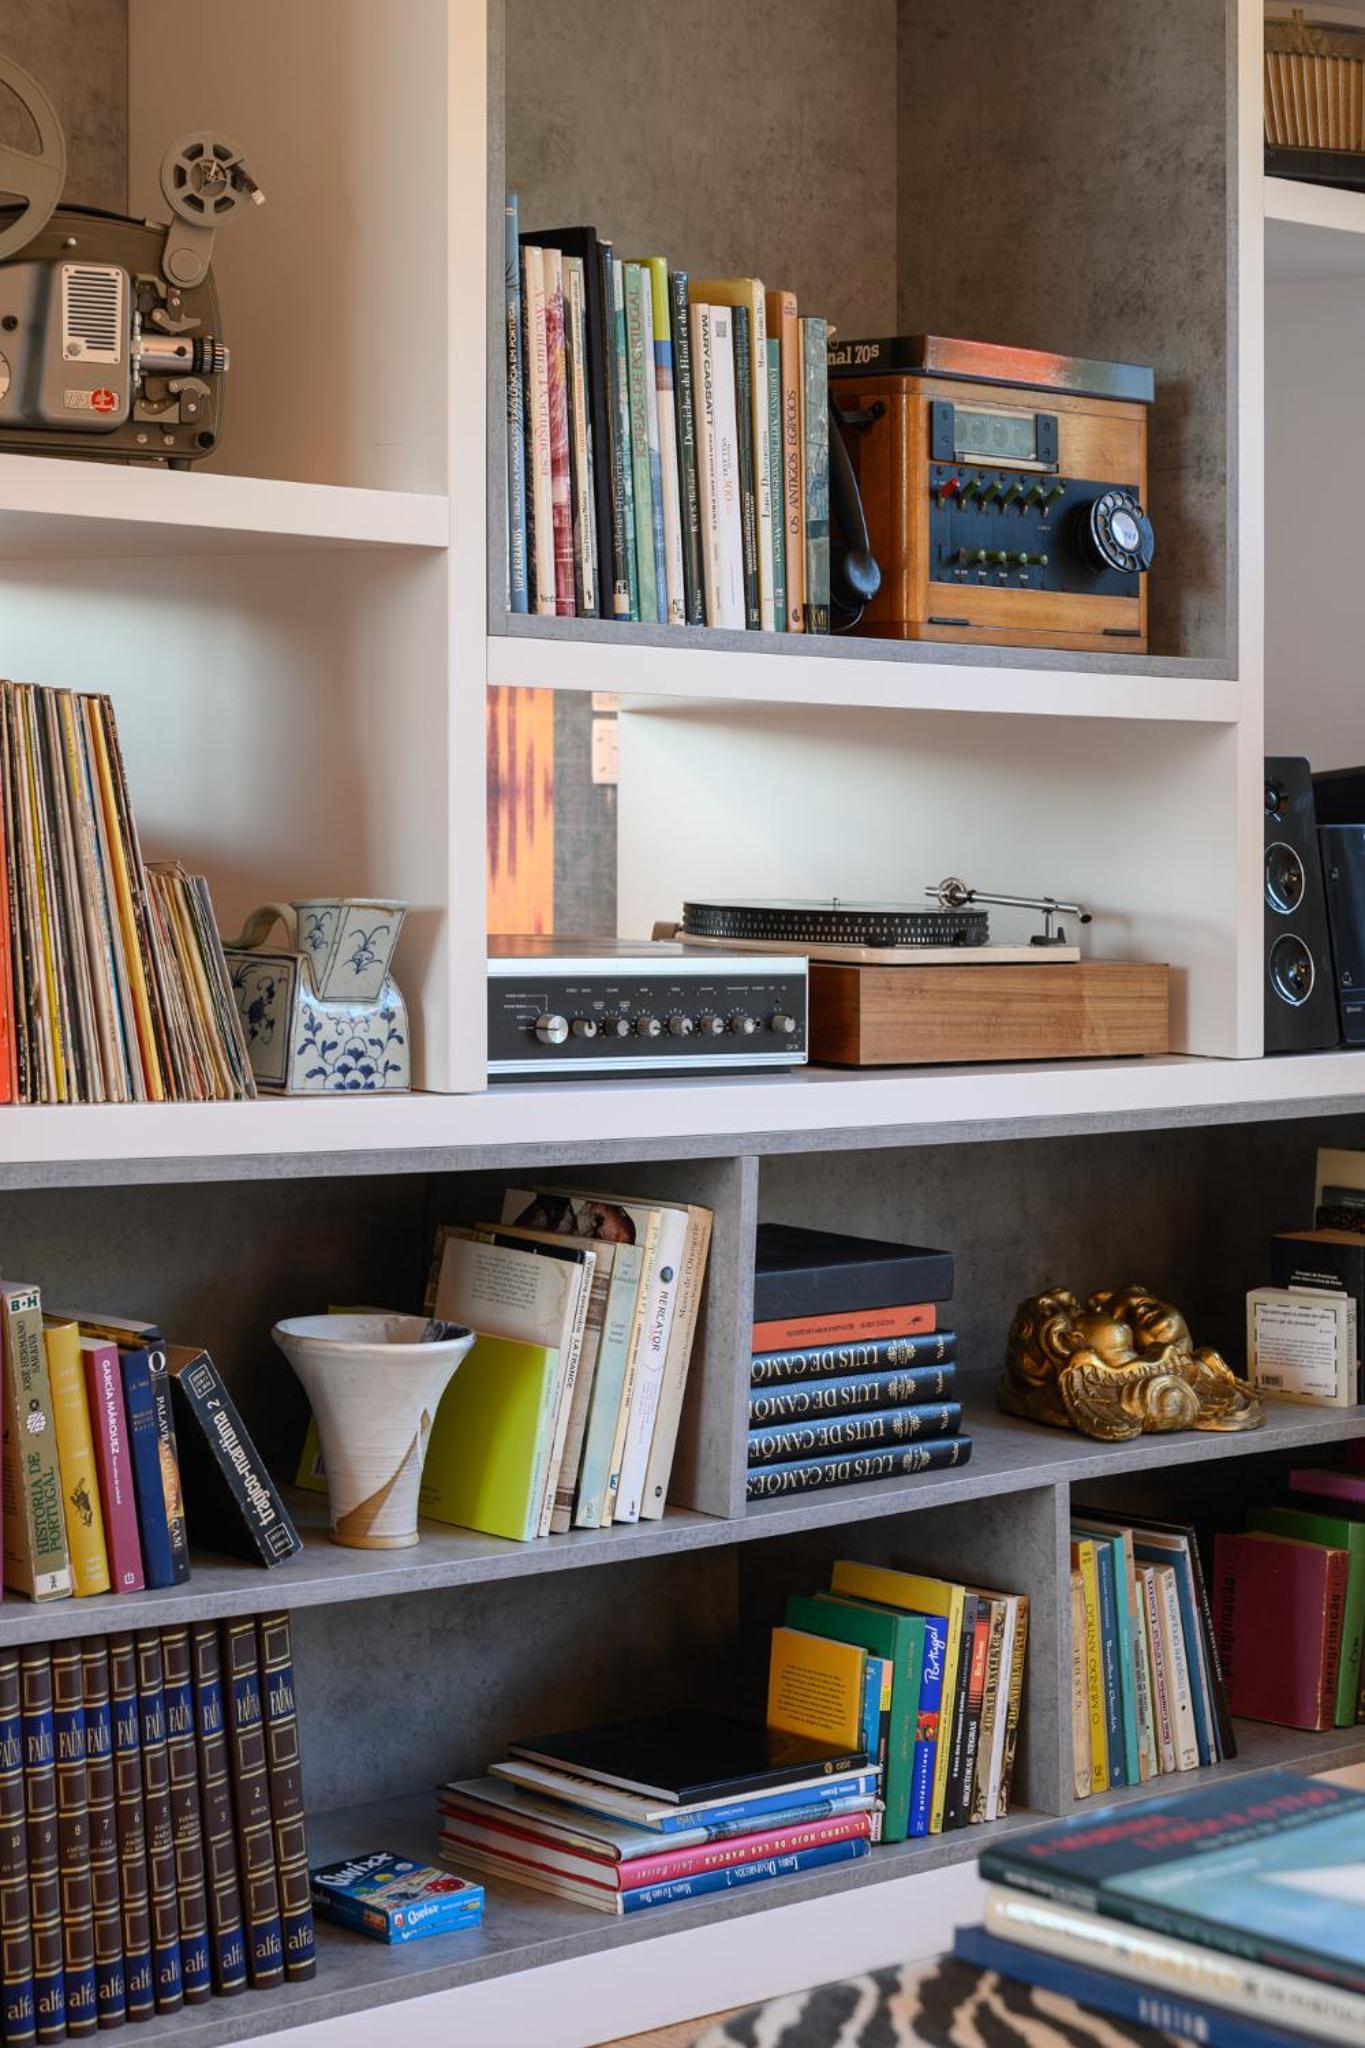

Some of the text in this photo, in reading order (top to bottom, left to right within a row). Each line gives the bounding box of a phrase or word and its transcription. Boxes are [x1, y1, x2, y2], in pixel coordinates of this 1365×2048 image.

[676, 279, 687, 306] Sind
[508, 302, 517, 348] PORTUGAL
[628, 287, 642, 370] PORTUGAL
[678, 309, 687, 325] du
[678, 327, 688, 337] et
[509, 349, 517, 363] EM
[679, 340, 689, 368] Hind
[855, 344, 880, 364] 70s
[681, 373, 691, 387] du
[701, 314, 713, 426] MARY CASSATT
[632, 375, 644, 394] DE
[511, 435, 521, 473] MARCAS
[786, 390, 799, 534] OS ANTIGOS EGÍPCIOS
[512, 528, 525, 592] SUPERBRANDS
[16, 1320, 31, 1368] HERMANO
[27, 1334, 41, 1375] SARAIVA
[573, 1339, 581, 1351] LA
[566, 1352, 578, 1389] FRANCE
[751, 1345, 878, 1383] LUIS DE CAMÕ
[102, 1359, 119, 1454] GARCÍA MÁRQUEZ
[749, 1381, 879, 1421] LUIS DE CAMÕ
[155, 1395, 171, 1457] PALAVRAS
[748, 1418, 884, 1460] LUIS DE CAMÕE
[206, 1398, 276, 1526] trágico-marítima 2
[824, 1461, 850, 1483] DE
[854, 1454, 893, 1477] LUIS
[27, 1452, 50, 1556] HISTÓRIA DE
[44, 1466, 63, 1552] PORTUGAL
[923, 1625, 945, 1686] Portugal
[966, 1720, 977, 1755] NEGRAS
[254, 1787, 261, 1798] 2
[288, 1779, 292, 1789] 1
[185, 1797, 192, 1807] 4
[74, 1824, 81, 1836] 8
[102, 1818, 109, 1830] 7
[134, 1813, 140, 1824] 6
[221, 1812, 227, 1822] 3
[12, 1835, 20, 1847] 10
[704, 1821, 866, 1865] EL LIBRO ROJO DE LAS MARCAS
[314, 1852, 394, 1887] Qwixx
[256, 1932, 281, 1958] alfa
[288, 1926, 313, 1951] alfa
[185, 1949, 208, 1973] alf
[222, 1945, 244, 1969] alf
[130, 1967, 151, 1993] alf
[160, 1960, 179, 1984] alf
[99, 1974, 125, 2000] alfa
